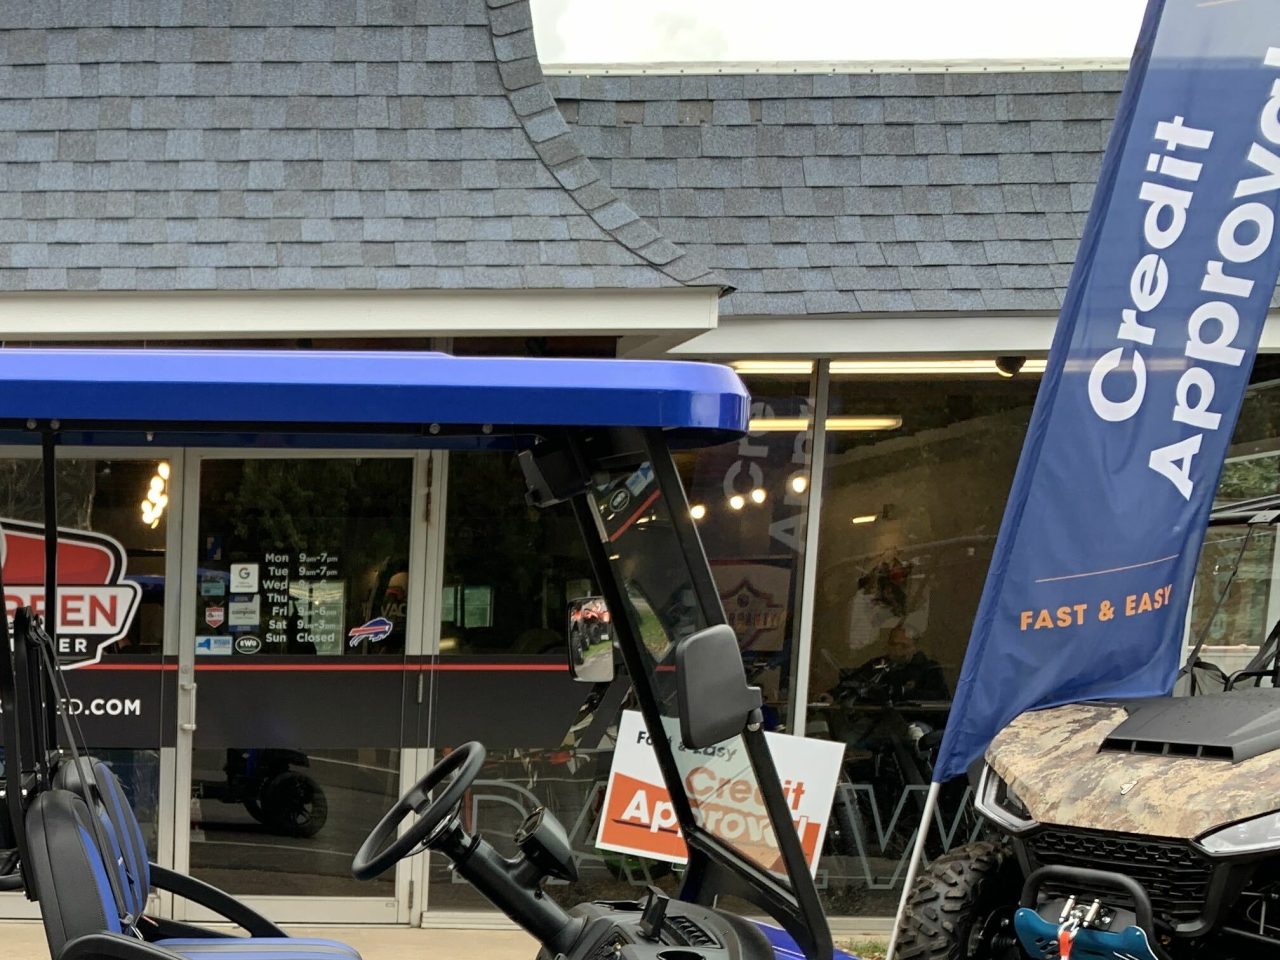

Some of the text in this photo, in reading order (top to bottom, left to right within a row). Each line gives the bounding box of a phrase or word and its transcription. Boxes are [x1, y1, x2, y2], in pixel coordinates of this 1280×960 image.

[1088, 115, 1214, 423] Credit
[1148, 47, 1280, 501] Approv
[265, 553, 338, 563] Mon 9am-7pm
[268, 566, 338, 576] Tue 9am-7pm
[262, 577, 288, 590] Wed
[267, 593, 288, 602] Thu
[272, 607, 288, 616] Fri
[1020, 584, 1173, 631] FAST & EASY
[268, 619, 288, 630] Sat
[265, 633, 335, 643] Sun Closed
